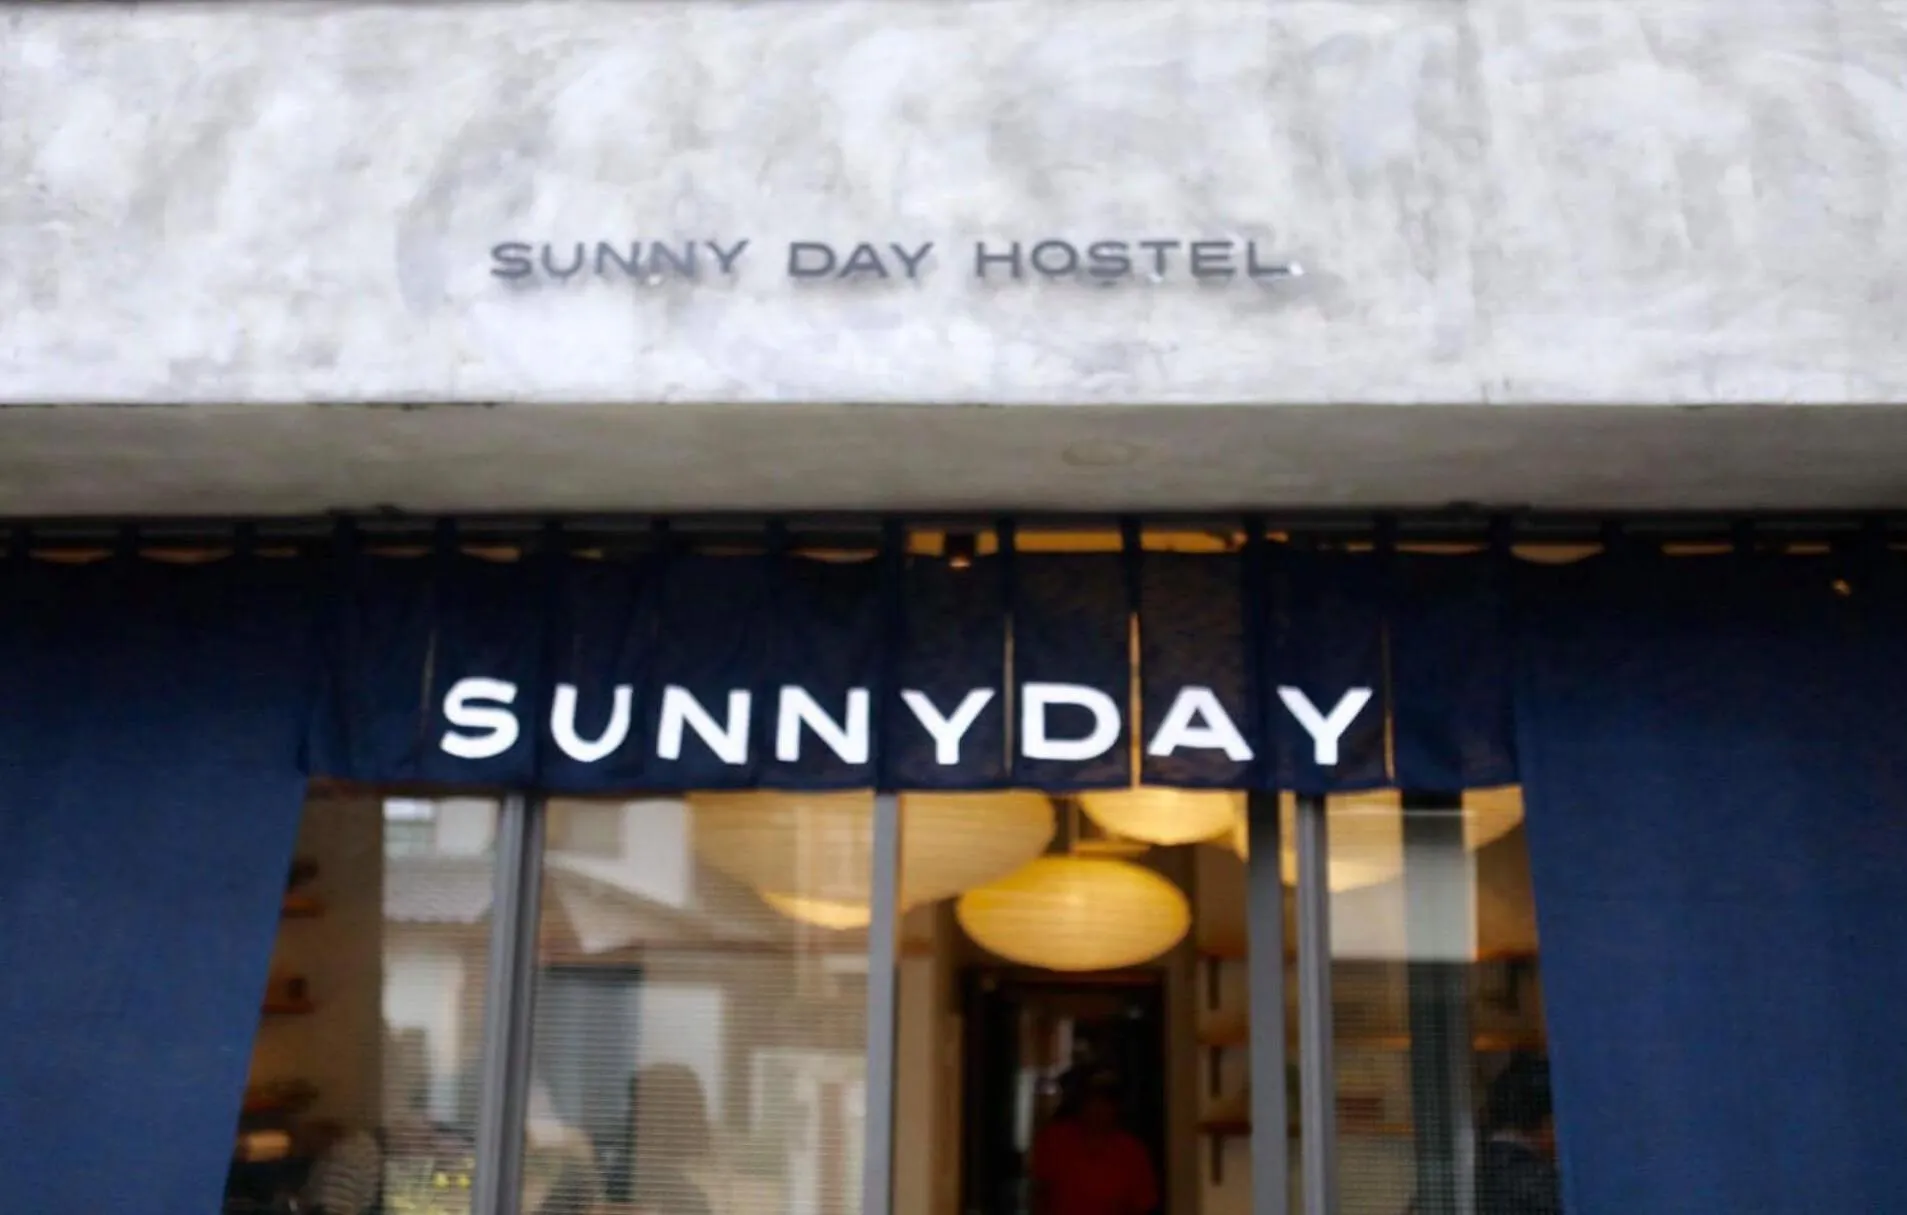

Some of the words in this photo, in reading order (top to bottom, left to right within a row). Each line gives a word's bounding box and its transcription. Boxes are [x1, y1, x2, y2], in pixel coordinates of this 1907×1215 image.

[489, 239, 750, 280] SUNNY
[787, 240, 935, 279] DAY
[975, 238, 1290, 280] HOSTEL
